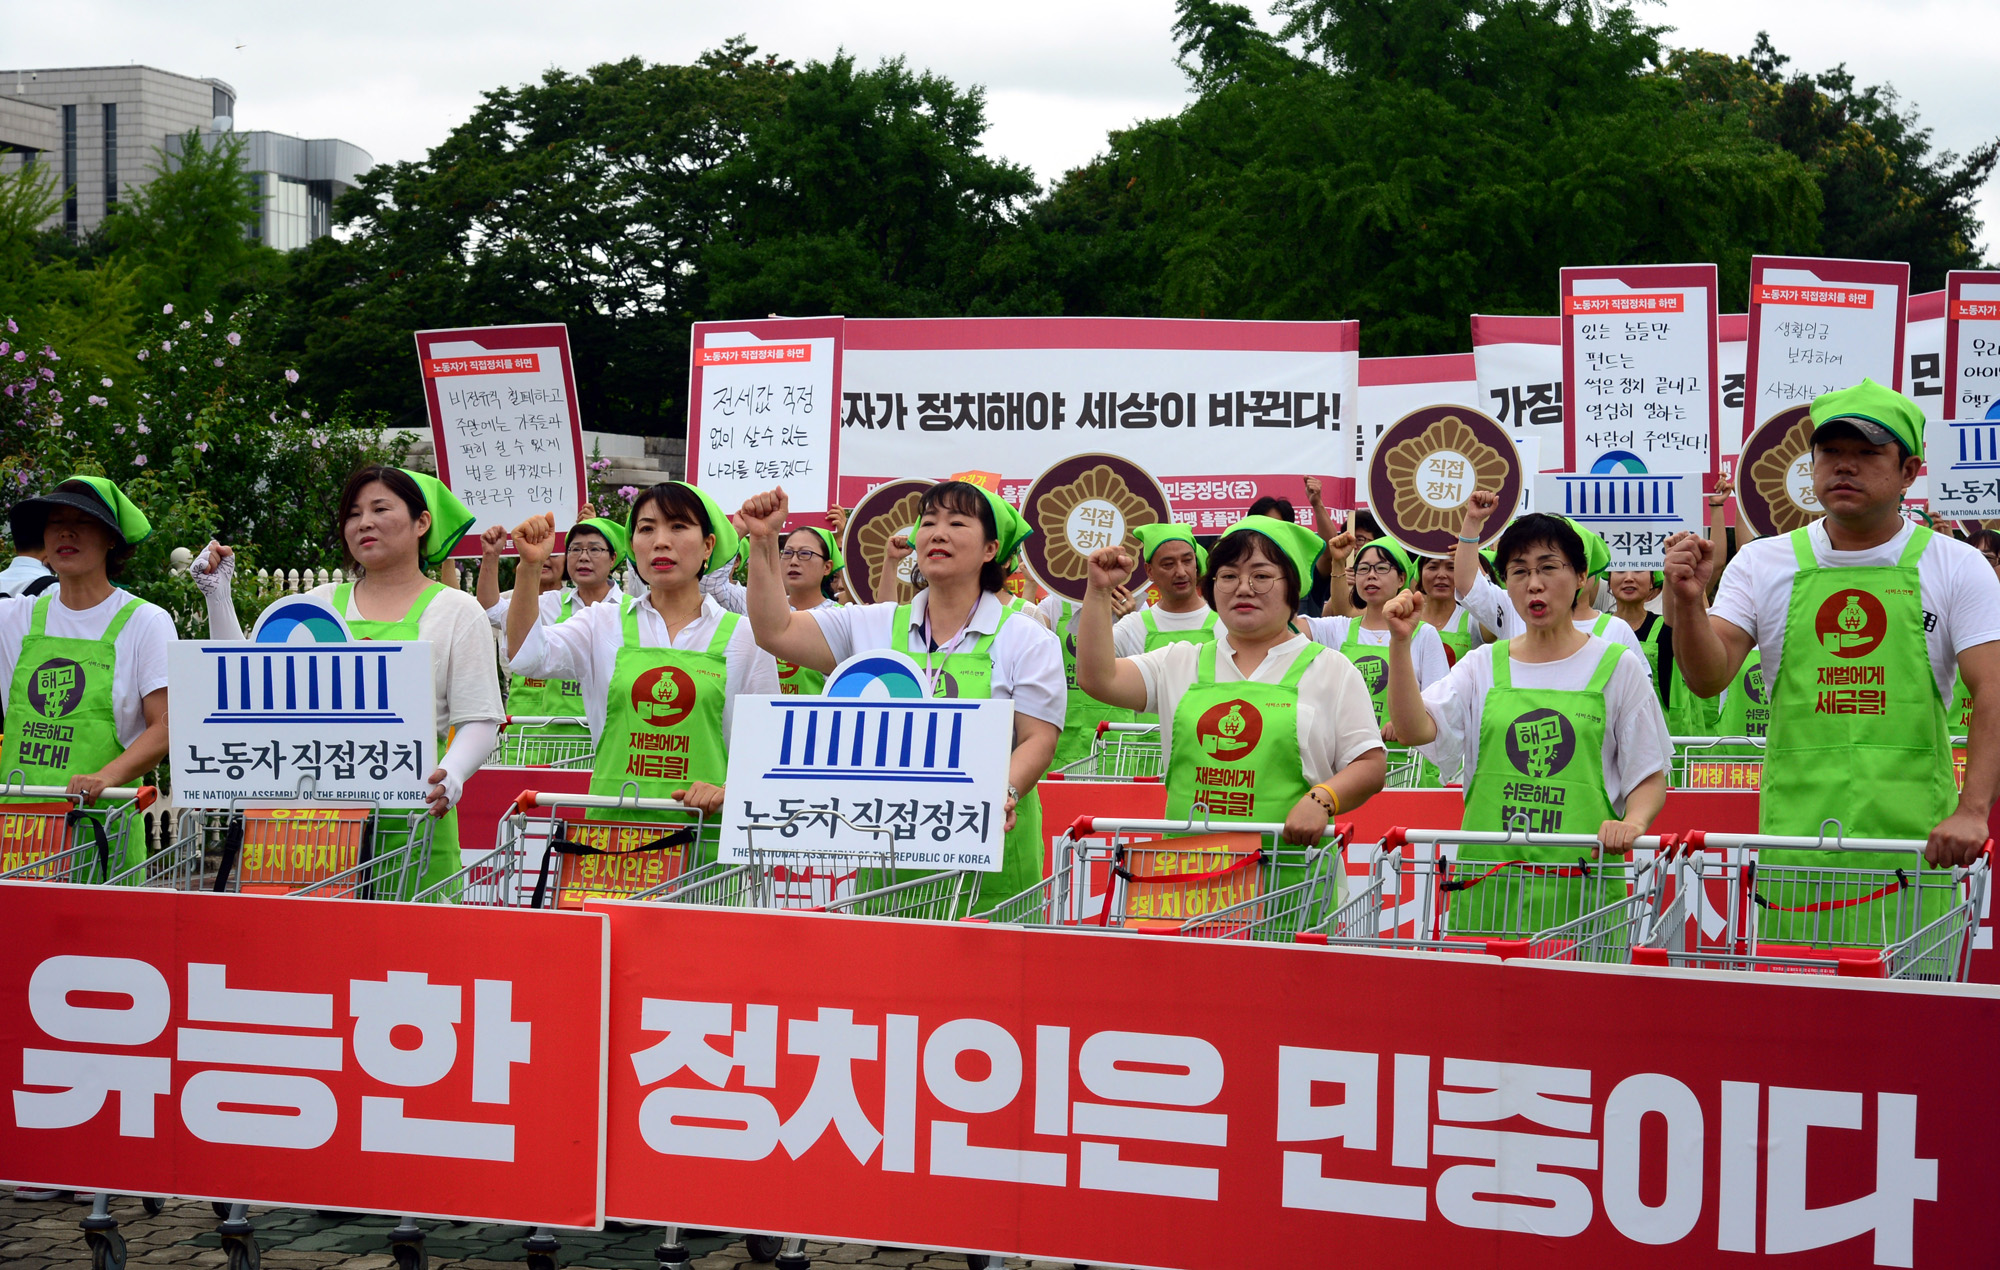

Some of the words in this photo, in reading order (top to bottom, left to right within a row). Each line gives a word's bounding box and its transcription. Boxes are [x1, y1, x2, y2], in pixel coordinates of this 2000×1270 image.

[1573, 300, 1609, 311] 노동자가
[1611, 298, 1657, 310] 직접정치를
[1659, 297, 1677, 309] 하면
[1761, 289, 1799, 301] 노동자가
[1800, 290, 1846, 304] 직접정치를
[1848, 292, 1867, 305] 하면
[1959, 304, 1997, 317] 노동자가
[1581, 323, 1610, 341] 있는
[1624, 321, 1671, 341] 놈들만
[1774, 321, 1830, 341] 생활임금
[433, 360, 469, 373] 노동자가
[469, 358, 514, 371] 직접정치를
[514, 357, 533, 369] 하면
[703, 349, 740, 362] 노동자가
[740, 348, 785, 361] 직접정치를
[786, 347, 805, 359] 하면
[1788, 346, 1843, 366] 보장하여
[1964, 366, 2000, 378] 아이
[1584, 376, 1615, 396] 썩은
[1619, 376, 1645, 395] 정치
[1655, 376, 1701, 396] 끝내고
[449, 388, 502, 410] 비정규직
[713, 384, 774, 416] 전세값
[783, 384, 814, 415] 걱정
[841, 391, 908, 431] 자가
[917, 391, 1067, 432] 정치해야
[1075, 391, 1197, 430] 세상이
[1208, 390, 1341, 431] 바뀐다!
[1585, 402, 1633, 421] 열심히
[1643, 401, 1687, 421] 일하는
[514, 413, 563, 432] 가족들과
[710, 426, 734, 450] 없이
[781, 423, 809, 447] 있는
[1585, 430, 1634, 449] 사람이
[460, 441, 487, 459] 편히
[494, 440, 511, 458] 쉴
[513, 438, 525, 455] 수
[707, 459, 750, 481] 나라를
[754, 458, 814, 480] 만들겠다
[1428, 458, 1465, 480] 직접
[1796, 461, 1814, 479] 직
[461, 487, 515, 508] 휴일근무
[1163, 480, 1258, 501] 민중정당(준)
[1426, 481, 1463, 503] 정치
[1799, 486, 1818, 505] 정
[1938, 478, 2000, 504] 노동자
[1080, 506, 1115, 529] 직접
[1950, 509, 1981, 517] NATIONAL
[1077, 529, 1112, 550] 정치
[1846, 607, 1861, 616] TAX
[41, 668, 74, 689] 해고
[660, 681, 673, 689] TAX
[1816, 665, 1885, 686] 재벌에게
[1815, 689, 1886, 715] 세금을!
[22, 720, 75, 743] 쉬운해고
[1519, 720, 1560, 745] 해고
[628, 732, 690, 753] 재벌에게
[19, 740, 71, 770] 반대!
[184, 739, 287, 781] 노동자
[291, 739, 424, 781] 직접정치
[625, 753, 690, 780] 세금을!
[1195, 766, 1255, 788] 재벌에게
[183, 789, 201, 800] THE
[202, 789, 248, 800] NATIONAL
[316, 790, 334, 800] THE
[336, 790, 381, 801] REPUBLIC
[383, 790, 395, 801] OF
[397, 790, 428, 801] KOREA
[1193, 789, 1255, 817] 세금을!
[1502, 781, 1566, 806] 쉬운해고
[267, 809, 341, 833] 우리가
[737, 796, 845, 840] 노동자
[850, 797, 991, 844] 직접정치
[1501, 805, 1563, 834] 반대!
[732, 847, 750, 858] THE
[893, 851, 941, 863] REPUBLIC
[942, 852, 956, 864] OF
[957, 853, 992, 865] KOREA
[1154, 844, 1232, 876] 우리가
[579, 854, 664, 883] 정치인은
[12, 953, 532, 1163] 유능한
[630, 996, 1228, 1201] 정치인은
[1276, 1044, 1939, 1270] 민중이다
